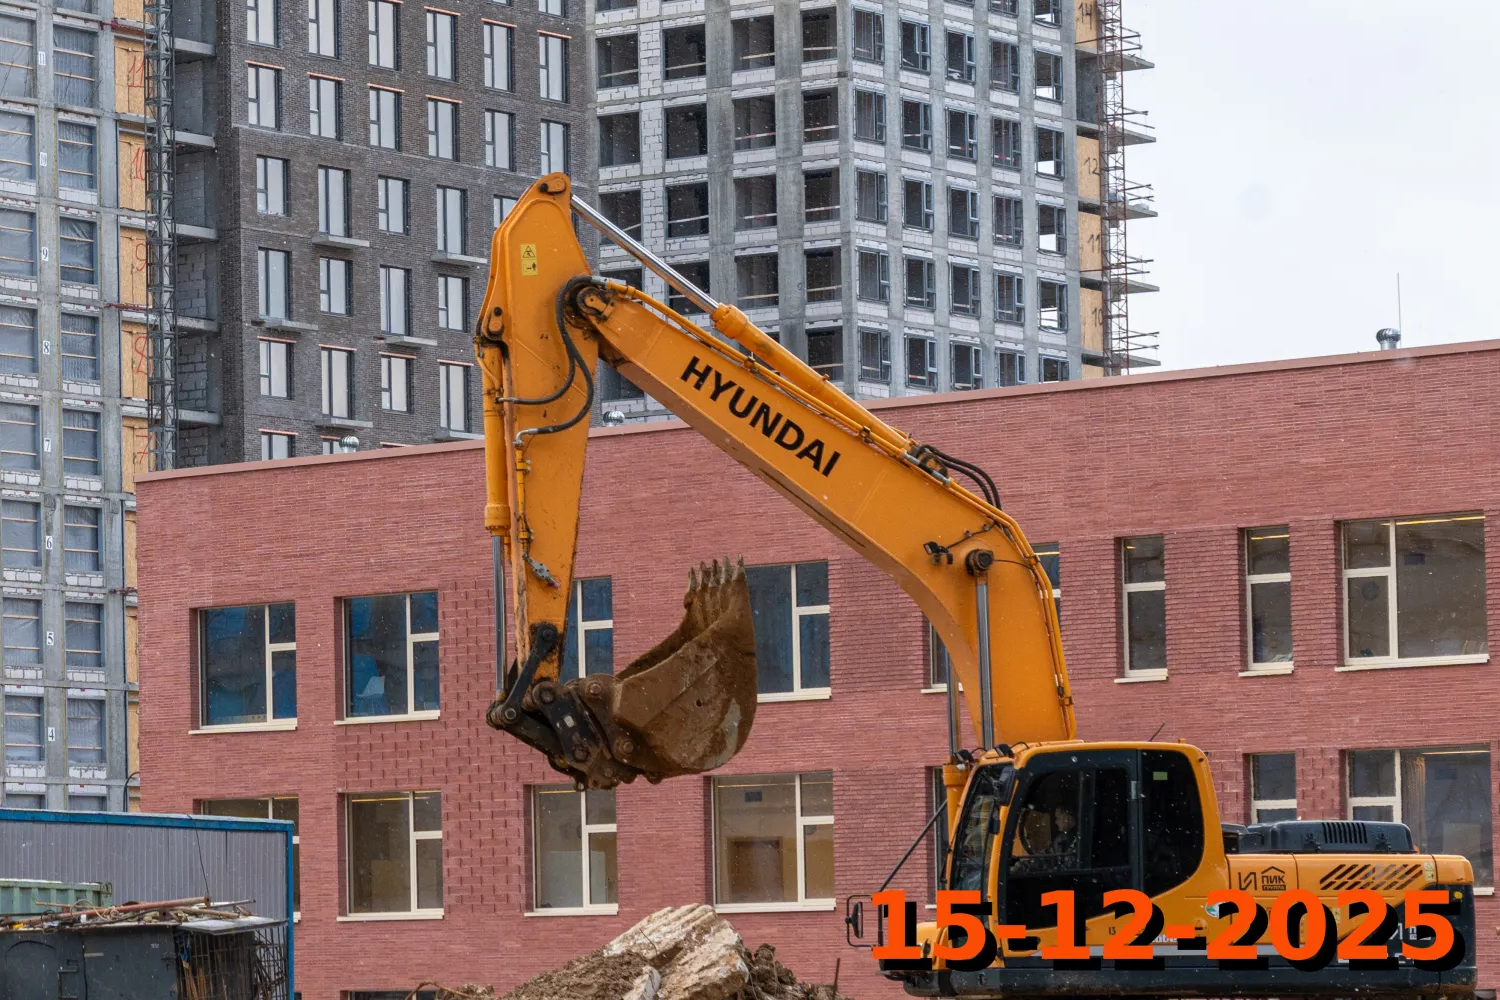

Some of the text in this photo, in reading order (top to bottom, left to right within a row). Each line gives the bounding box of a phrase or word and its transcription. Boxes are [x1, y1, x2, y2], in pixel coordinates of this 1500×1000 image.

[1078, 3, 1093, 30] 14
[128, 55, 145, 87] 11
[1084, 157, 1100, 176] 12
[42, 247, 48, 260] 9
[135, 243, 147, 271] 9
[43, 341, 49, 354] 8
[680, 356, 841, 478] HYUNDAI
[136, 434, 152, 464] 7
[46, 536, 52, 549] 6
[47, 632, 53, 645] 5
[49, 728, 54, 740] 4
[1261, 876, 1285, 884] ПИК
